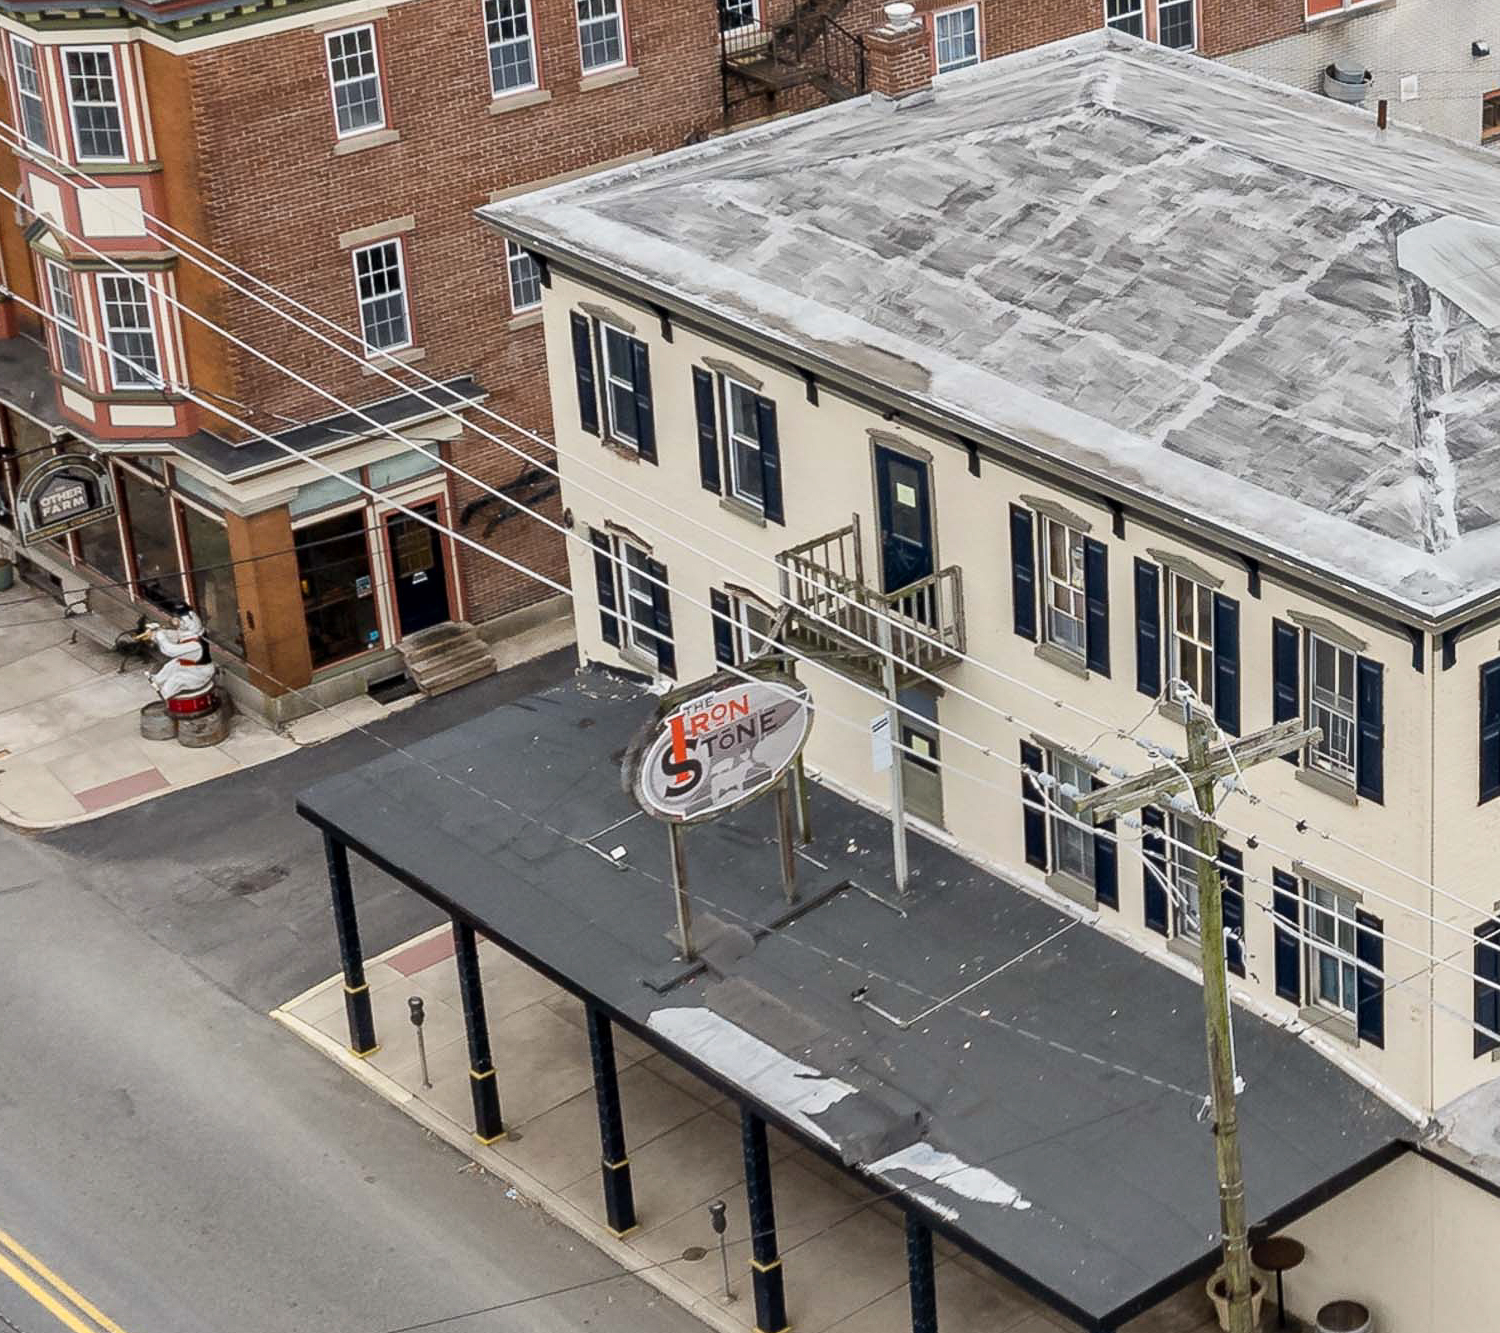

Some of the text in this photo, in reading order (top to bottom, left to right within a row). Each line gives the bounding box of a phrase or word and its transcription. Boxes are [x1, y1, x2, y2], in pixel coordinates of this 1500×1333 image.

[39, 486, 83, 508] OTHER
[42, 496, 86, 518] FARM
[683, 696, 715, 714] THE
